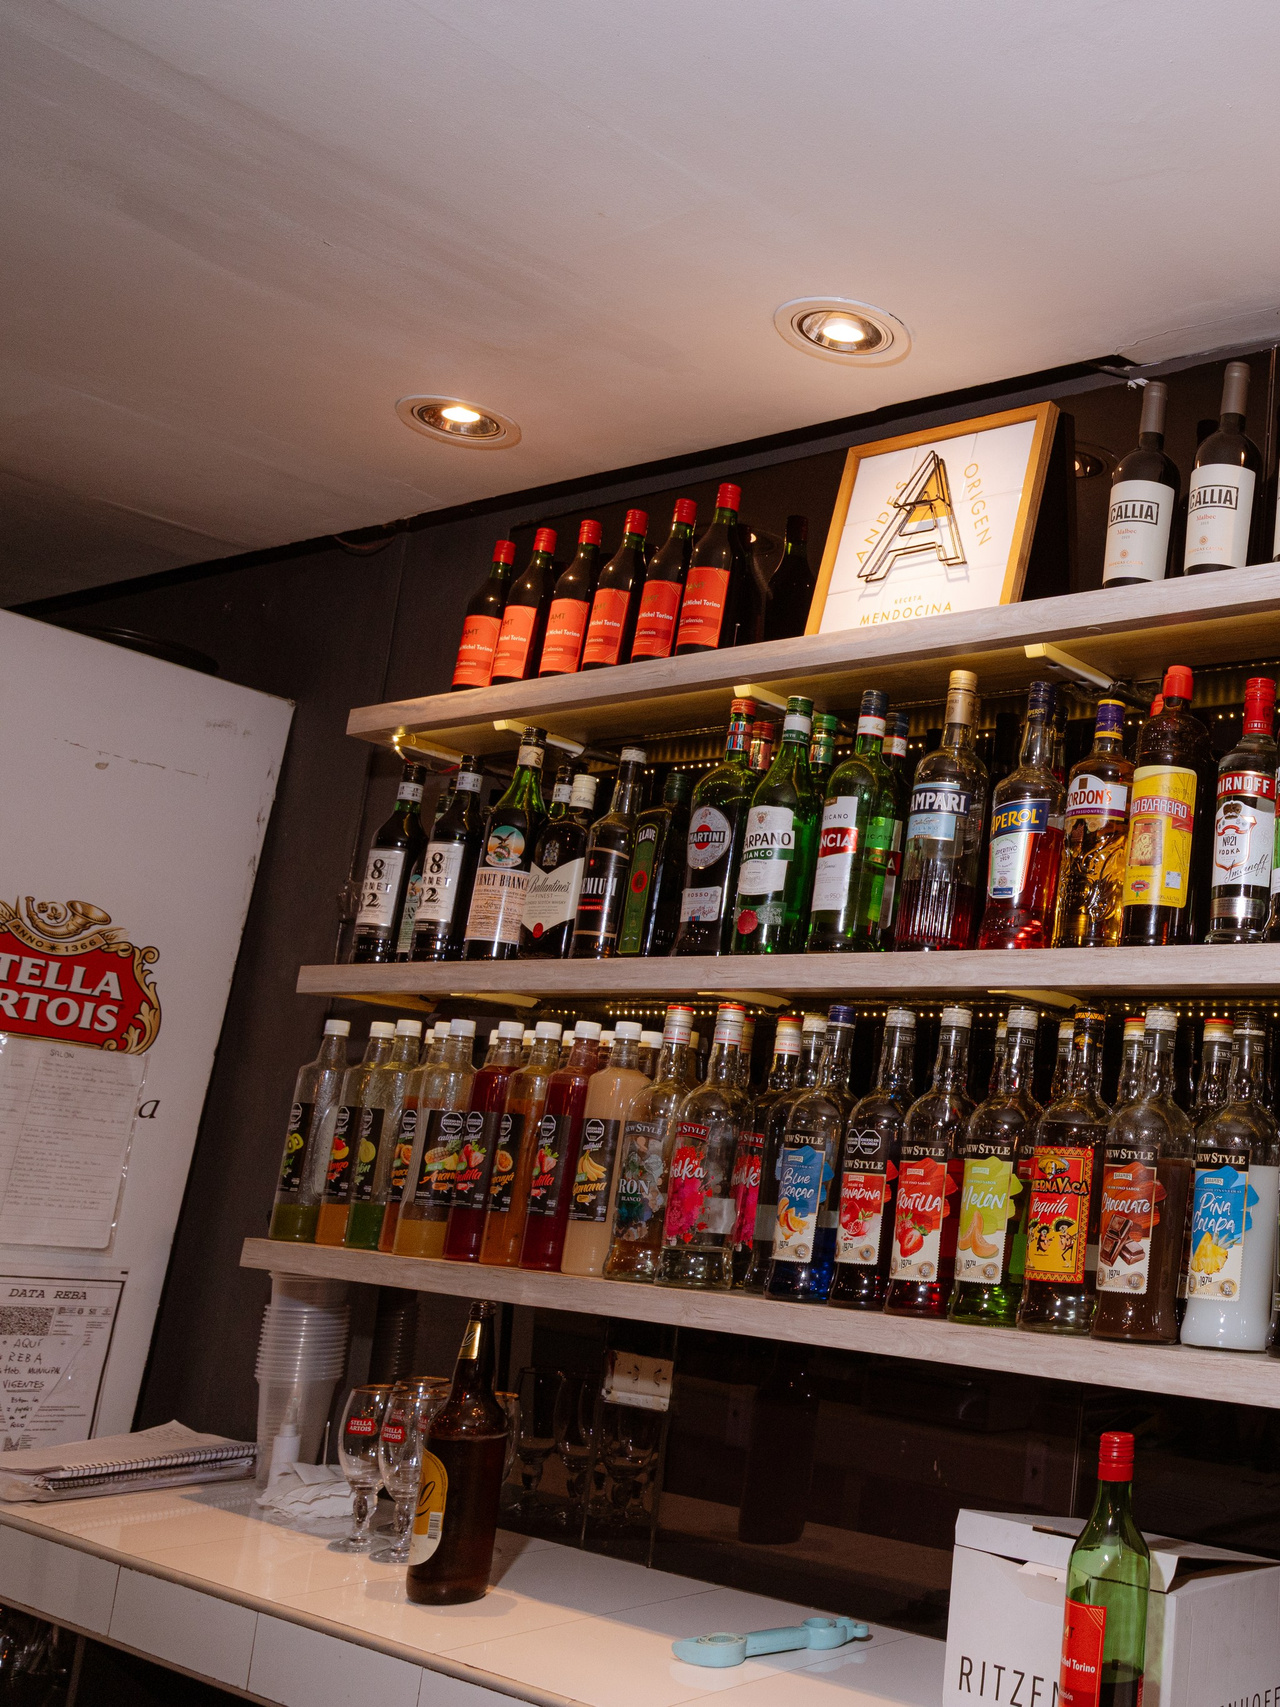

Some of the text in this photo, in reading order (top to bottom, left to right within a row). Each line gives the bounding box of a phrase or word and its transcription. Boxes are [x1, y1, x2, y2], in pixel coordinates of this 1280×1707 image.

[964, 463, 992, 546] ORIGEN
[1189, 489, 1233, 509] CALLIA
[1111, 504, 1154, 522] CALLIA
[703, 600, 721, 608] Torino
[894, 595, 922, 604] RECETA
[656, 612, 673, 620] Torino
[860, 602, 952, 626] MENDOCINA
[477, 644, 492, 652] Torino
[1217, 776, 1270, 796] MIRNOFF
[910, 792, 965, 812] AMPARI
[1141, 798, 1188, 819] BARREIRO
[991, 807, 1039, 834] APEROL
[689, 831, 725, 844] MARTINI
[744, 832, 792, 849] ARPANO
[1218, 848, 1241, 856] VODKA
[527, 875, 570, 896] Ballantine's
[12, 922, 98, 953] ANNO 1366
[0, 953, 123, 1002] TELLA
[0, 988, 119, 1032] RTOIS
[636, 1124, 662, 1135] STYLE
[683, 1125, 707, 1136] STYLE
[794, 1134, 824, 1145] STYLE
[913, 1146, 945, 1156] STYLE
[979, 1144, 1010, 1156] STYLE
[1120, 1149, 1154, 1161] STYLE
[854, 1159, 884, 1170] STYLE
[1211, 1152, 1245, 1165] STYLE
[619, 1179, 649, 1195] RON
[1032, 1197, 1068, 1216] tequila
[8, 1289, 87, 1300] DATA REBA
[3, 1380, 45, 1389] VIGENTES
[1072, 1658, 1096, 1673] Torino
